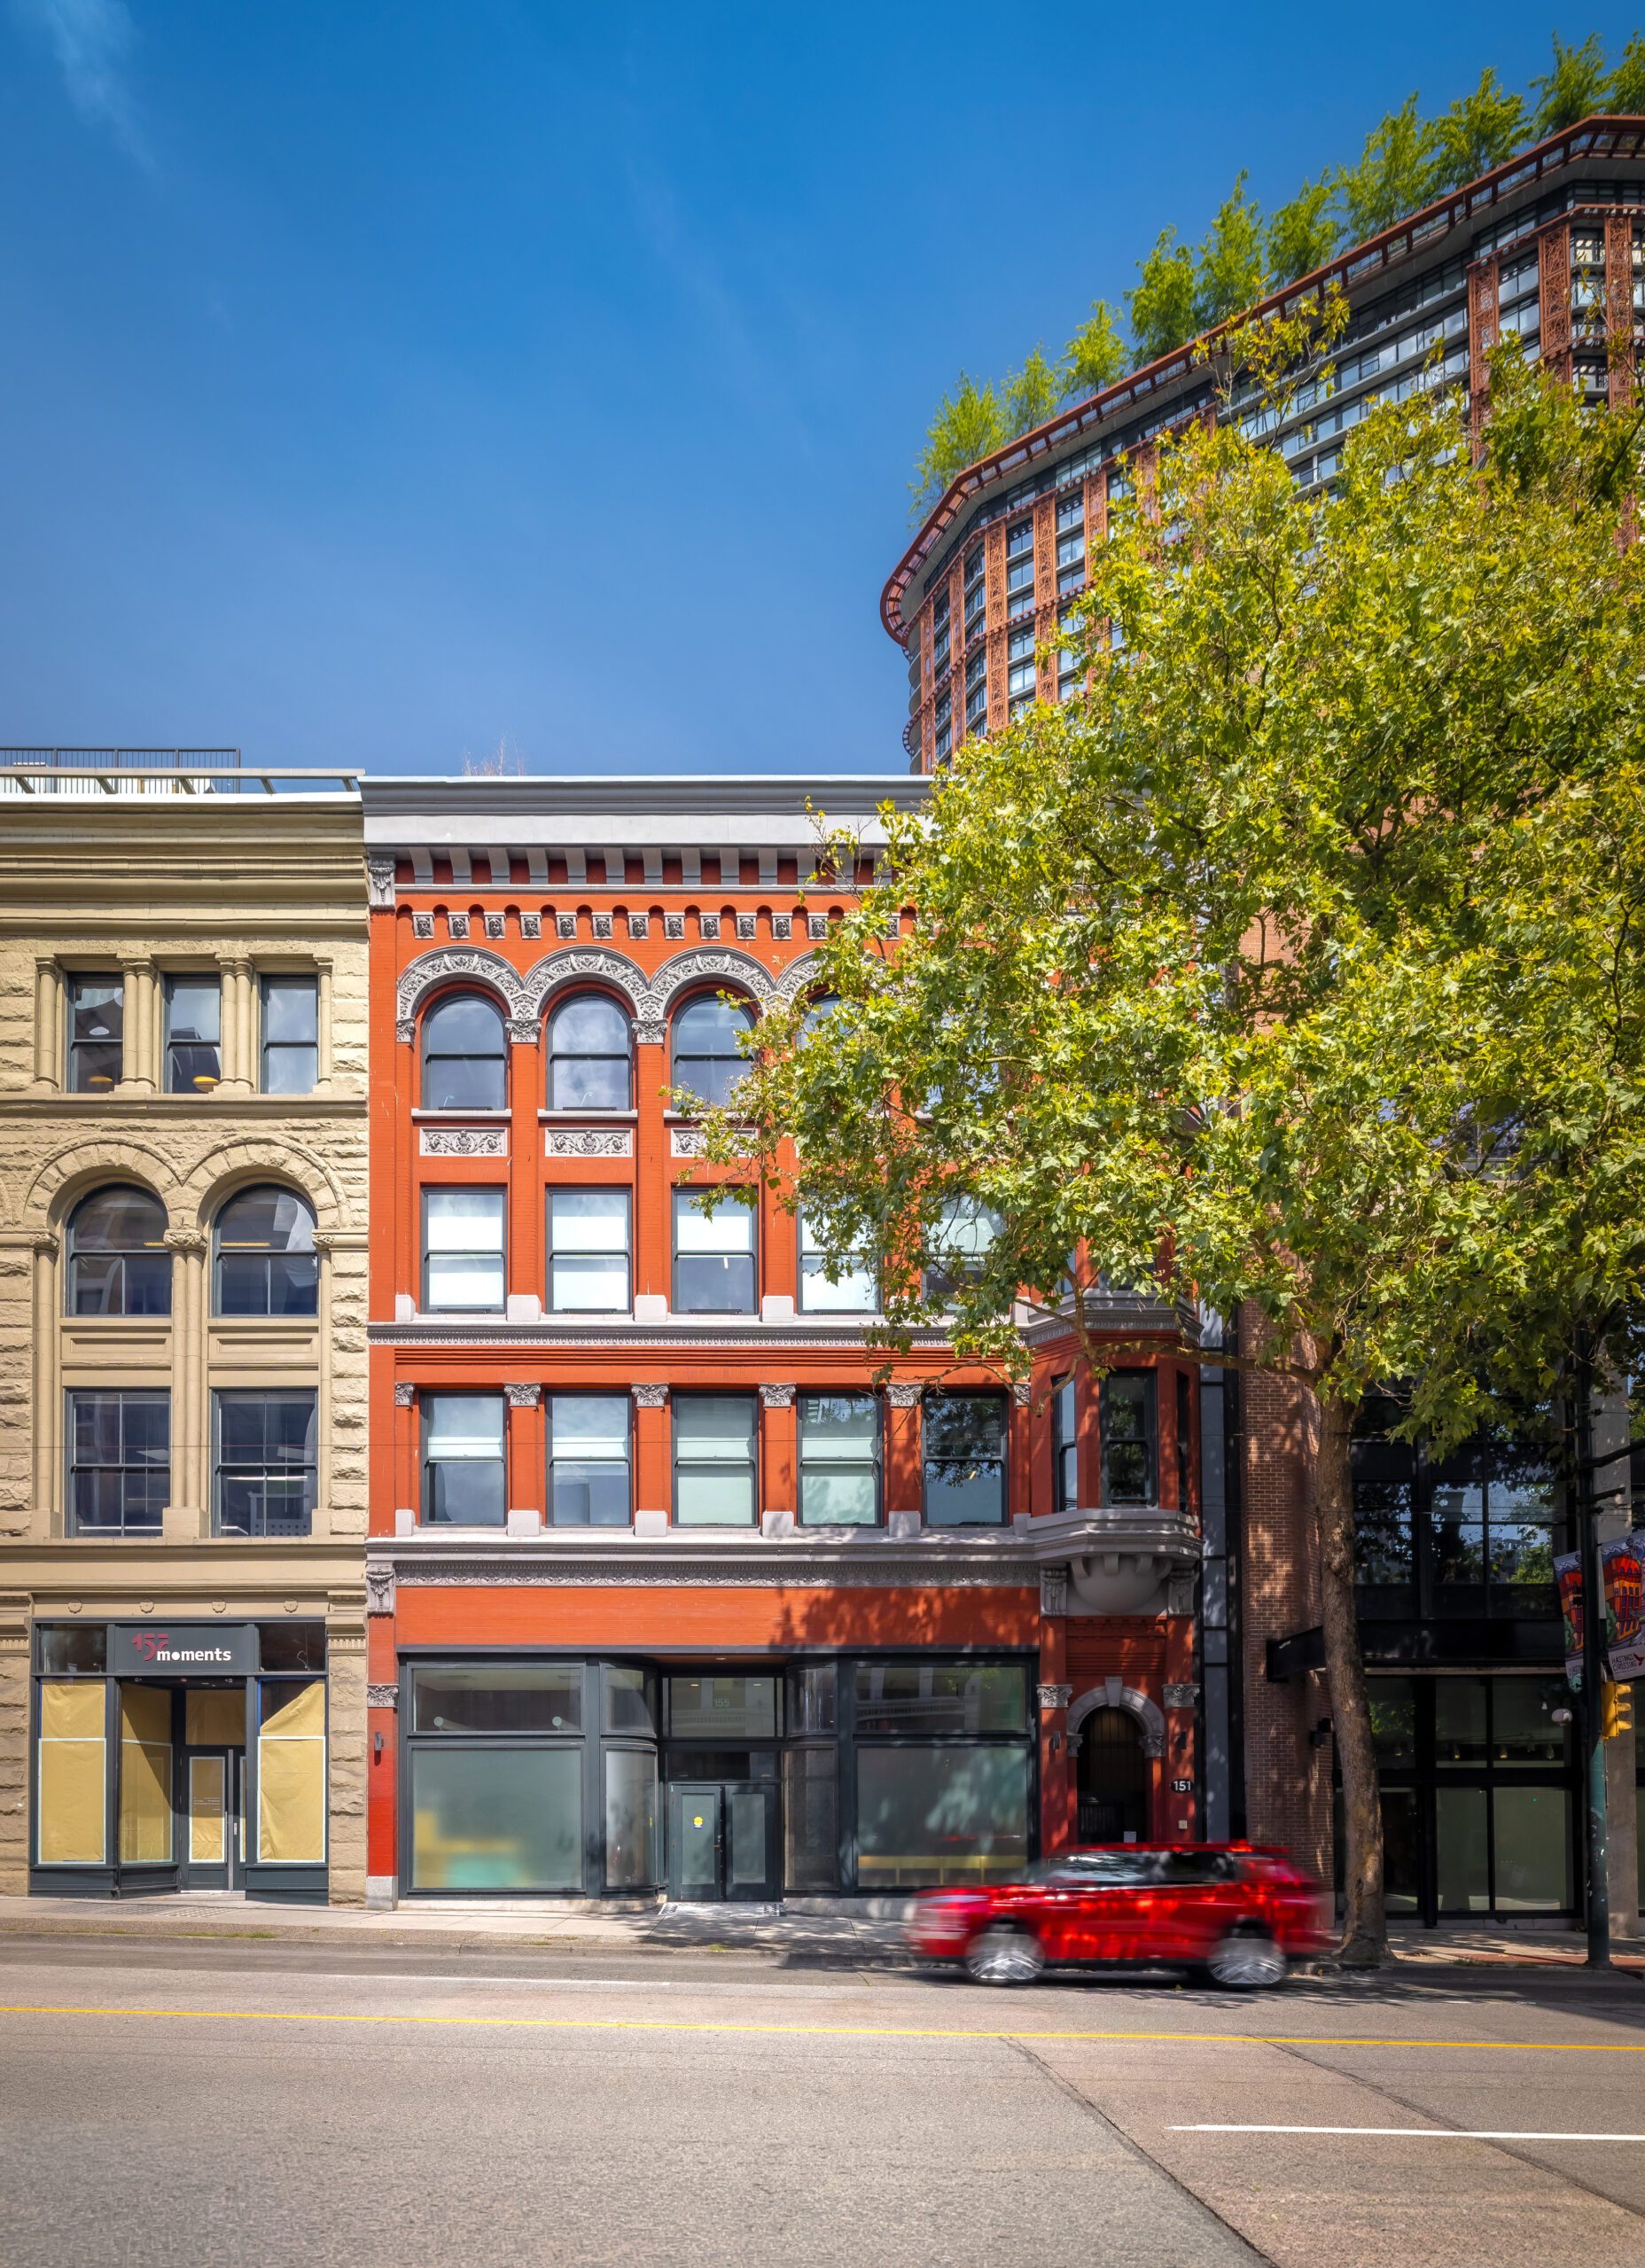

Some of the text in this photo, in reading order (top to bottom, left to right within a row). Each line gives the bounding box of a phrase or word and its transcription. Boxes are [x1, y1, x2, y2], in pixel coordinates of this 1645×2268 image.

[157, 1648, 231, 1661] moments
[1612, 1661, 1638, 1672] CROSSING
[714, 1698, 730, 1707] 155
[1173, 1781, 1190, 1791] 151
